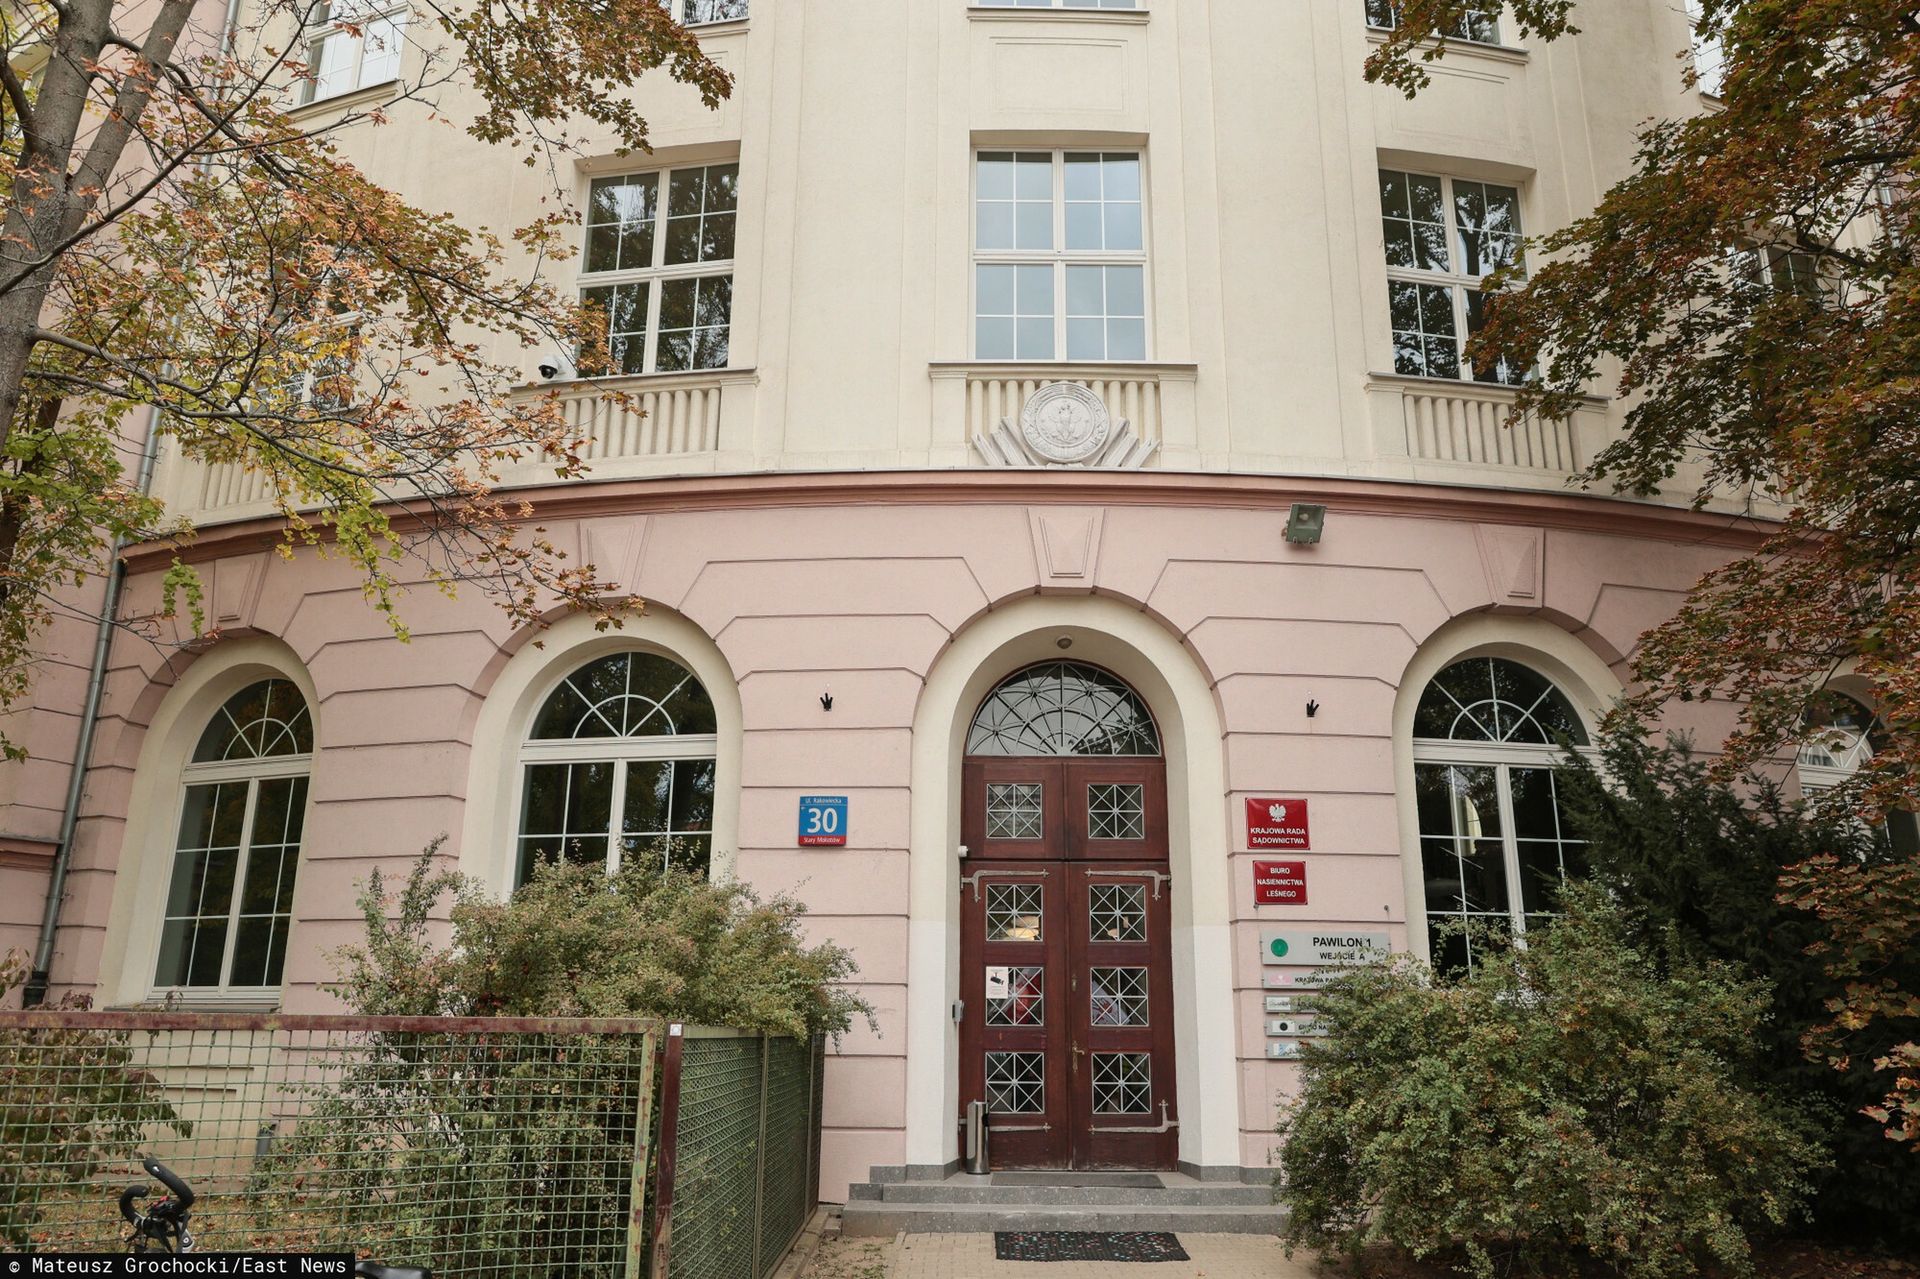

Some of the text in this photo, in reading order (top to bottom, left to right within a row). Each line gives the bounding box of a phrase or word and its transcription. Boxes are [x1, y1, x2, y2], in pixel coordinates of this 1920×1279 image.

[807, 807, 838, 833] 30
[1250, 827, 1285, 835] KRAJOWA
[1252, 836, 1305, 845] SĄDOWNICTWA
[1256, 878, 1304, 886] NASIENNICTWA
[1266, 889, 1297, 898] LEŚNEGO
[1312, 937, 1372, 948] PAWILON 1
